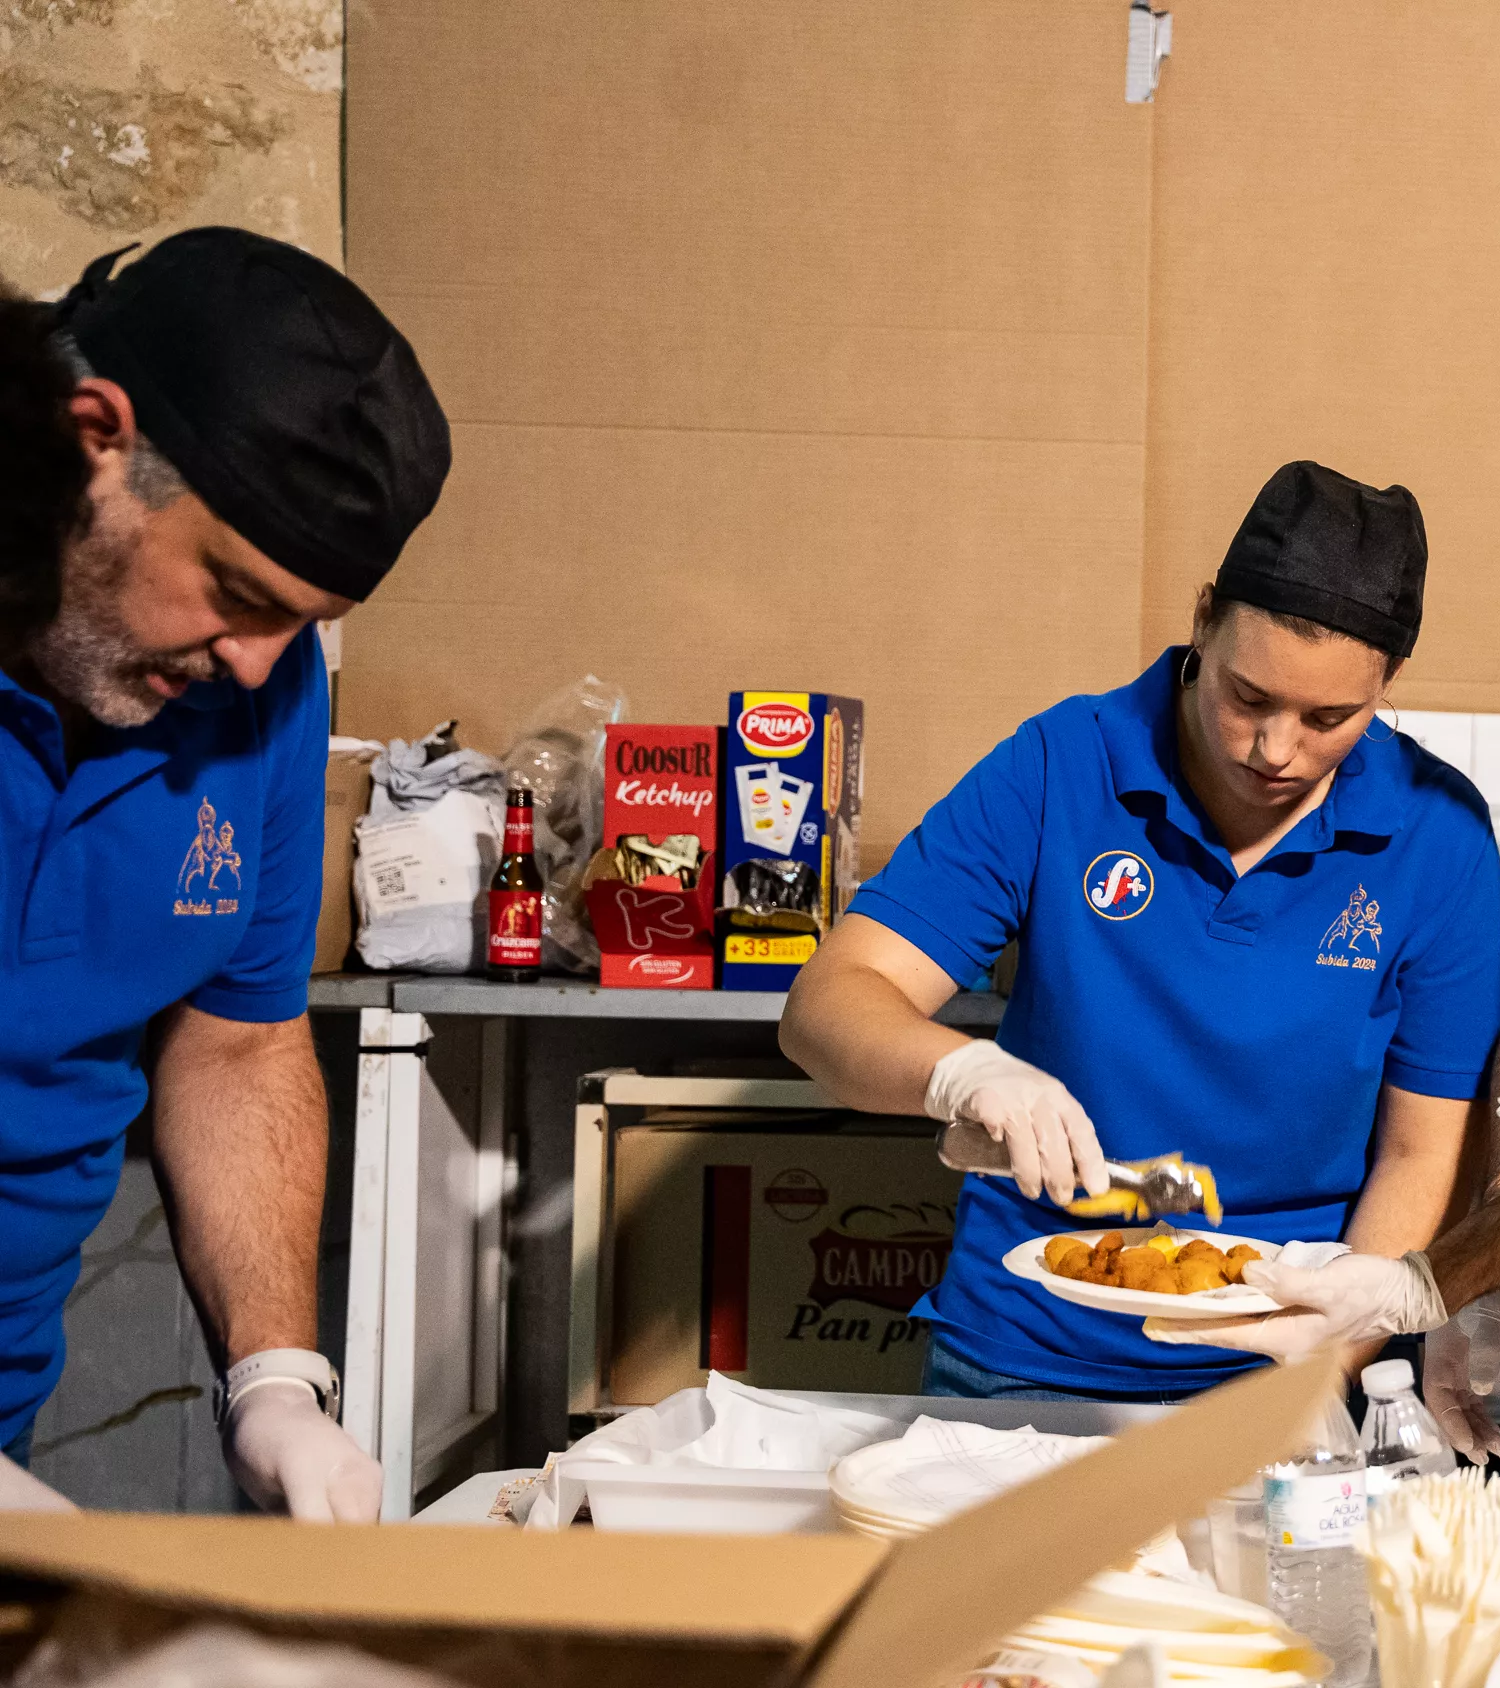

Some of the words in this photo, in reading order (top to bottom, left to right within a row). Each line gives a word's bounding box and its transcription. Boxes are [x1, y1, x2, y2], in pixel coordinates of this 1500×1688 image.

[745, 713, 806, 741] PRIMA
[616, 740, 711, 776] COOSUR
[615, 780, 713, 817] Ketchup
[173, 899, 212, 915] Subida
[215, 899, 239, 914] 2024
[1315, 953, 1349, 967] Subida
[1352, 956, 1376, 971] 2024
[823, 1247, 950, 1288] CAMPO
[785, 1304, 870, 1341] Pan
[1333, 1503, 1361, 1516] AGUA
[1319, 1517, 1339, 1531] DEL
